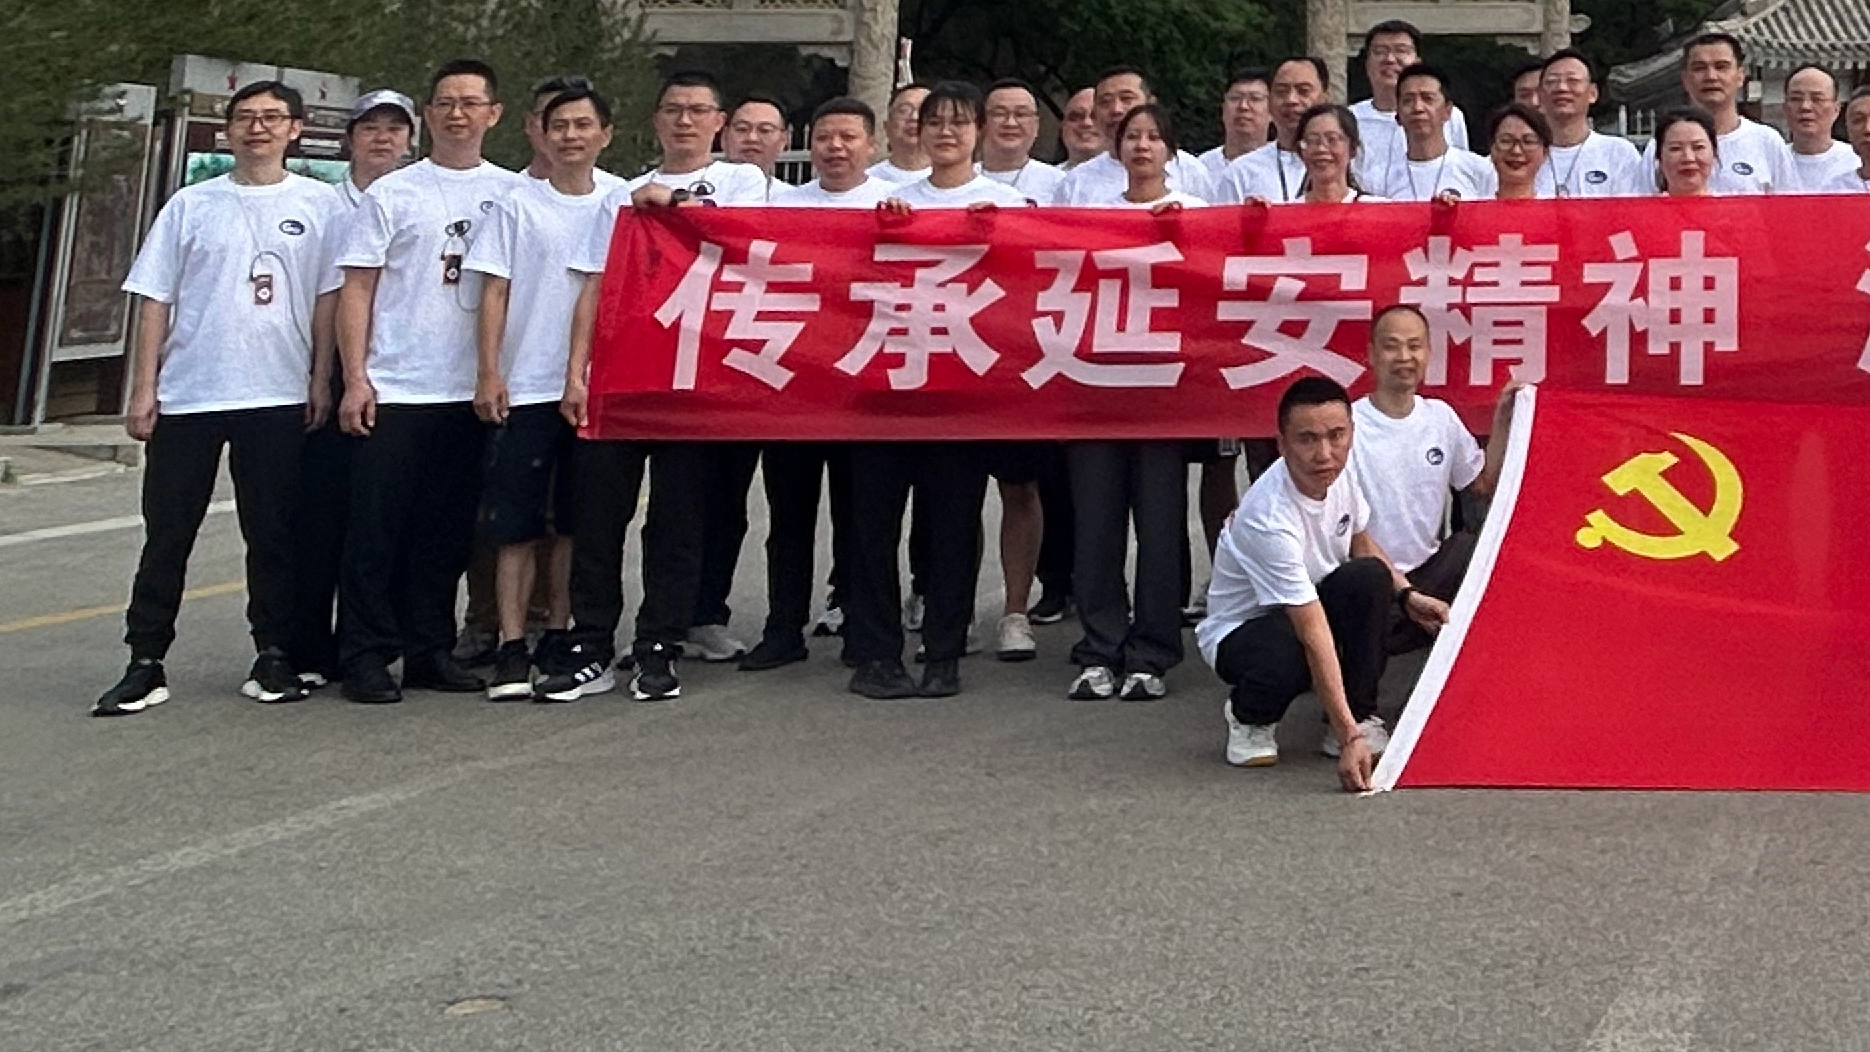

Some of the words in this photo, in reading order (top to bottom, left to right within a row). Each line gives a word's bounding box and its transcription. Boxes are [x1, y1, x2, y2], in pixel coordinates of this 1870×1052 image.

[655, 230, 1739, 391] 传承延安精神
